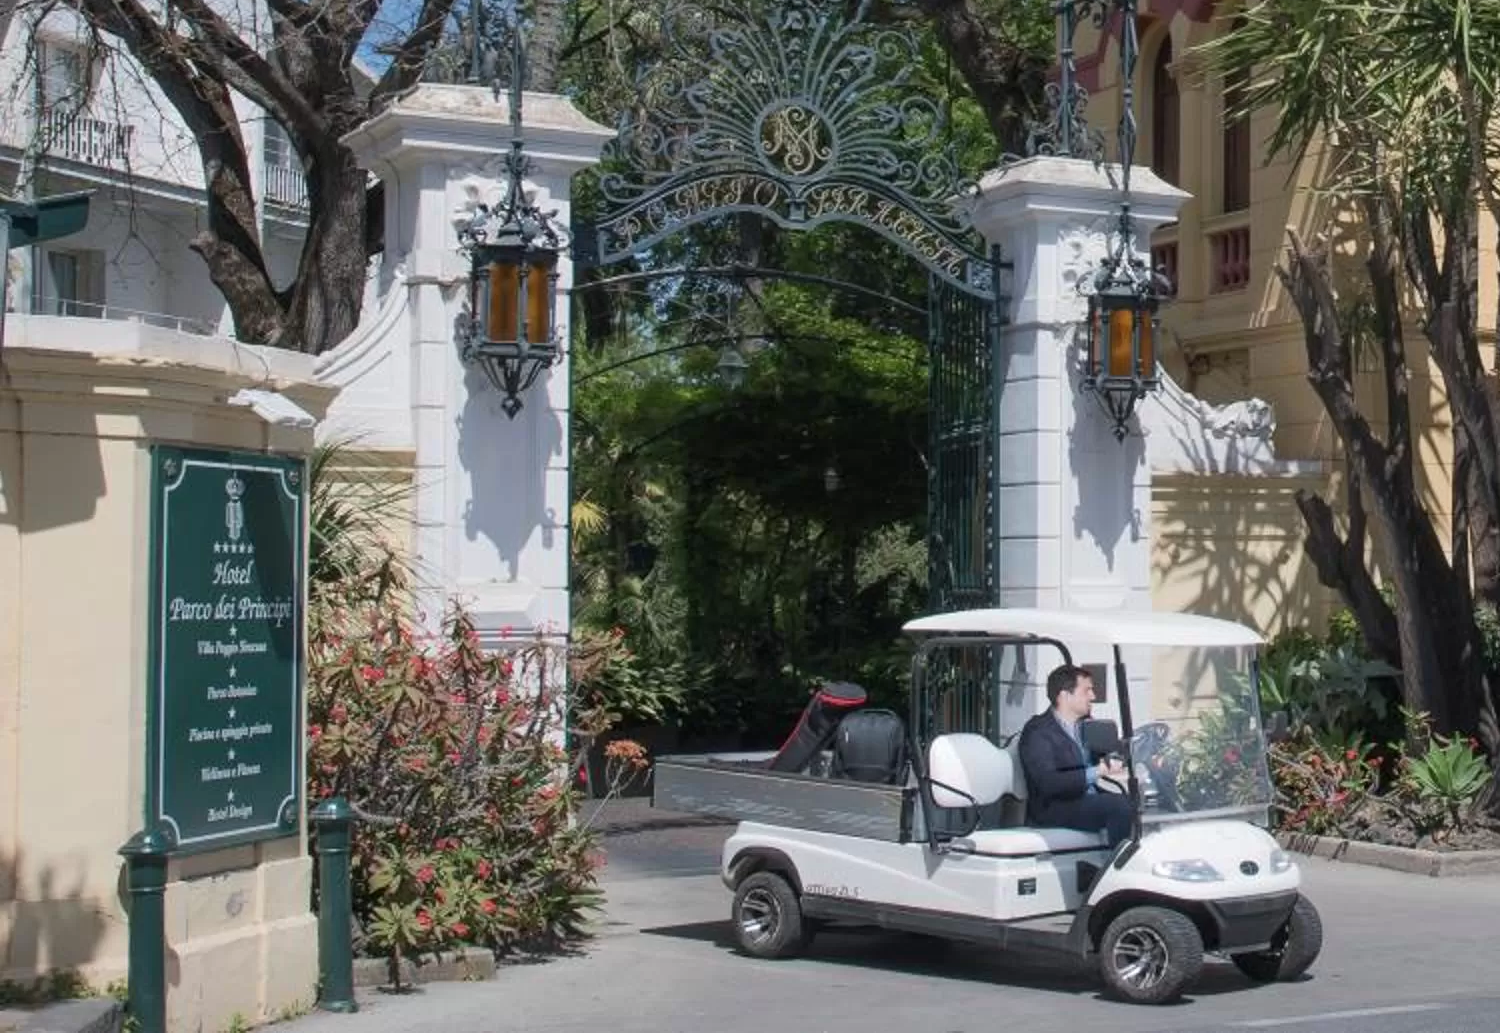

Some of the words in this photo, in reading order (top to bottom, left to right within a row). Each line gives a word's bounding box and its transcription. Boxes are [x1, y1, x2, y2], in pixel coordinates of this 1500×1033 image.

[212, 559, 254, 584] Hotel
[170, 597, 212, 621] Parco
[214, 593, 236, 619] dei
[237, 596, 292, 627] Principi
